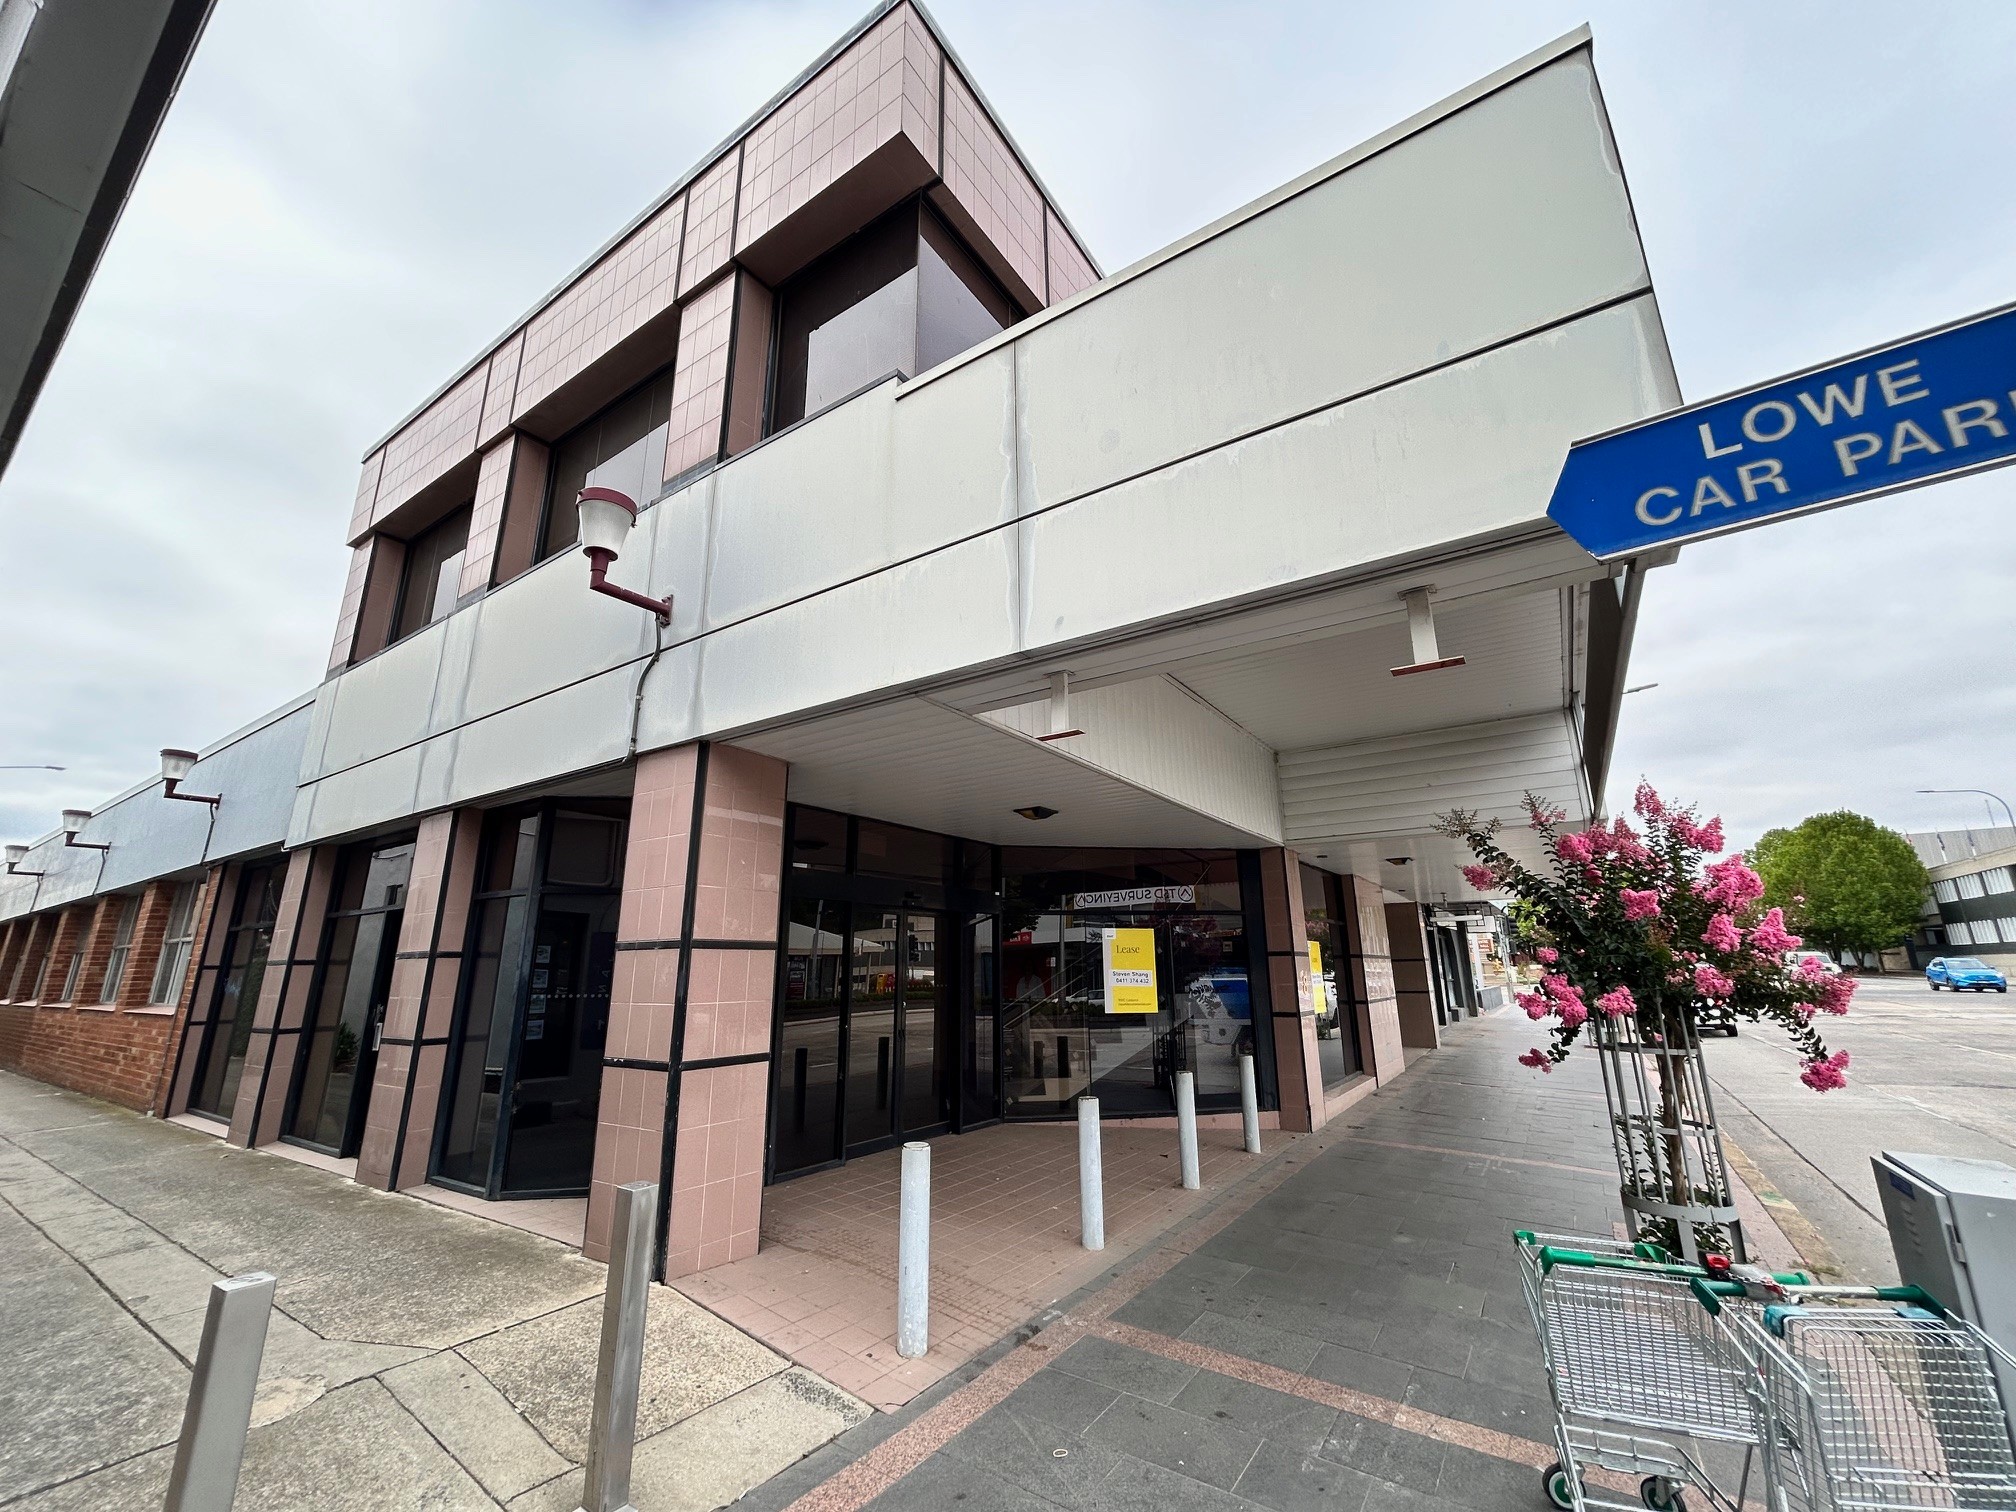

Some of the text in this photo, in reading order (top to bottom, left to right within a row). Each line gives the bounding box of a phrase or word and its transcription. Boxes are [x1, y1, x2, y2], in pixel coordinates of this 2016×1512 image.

[1634, 389, 2016, 527] CAR PAR
[1698, 359, 1930, 459] LOWE
[1116, 945, 1140, 954] Lease
